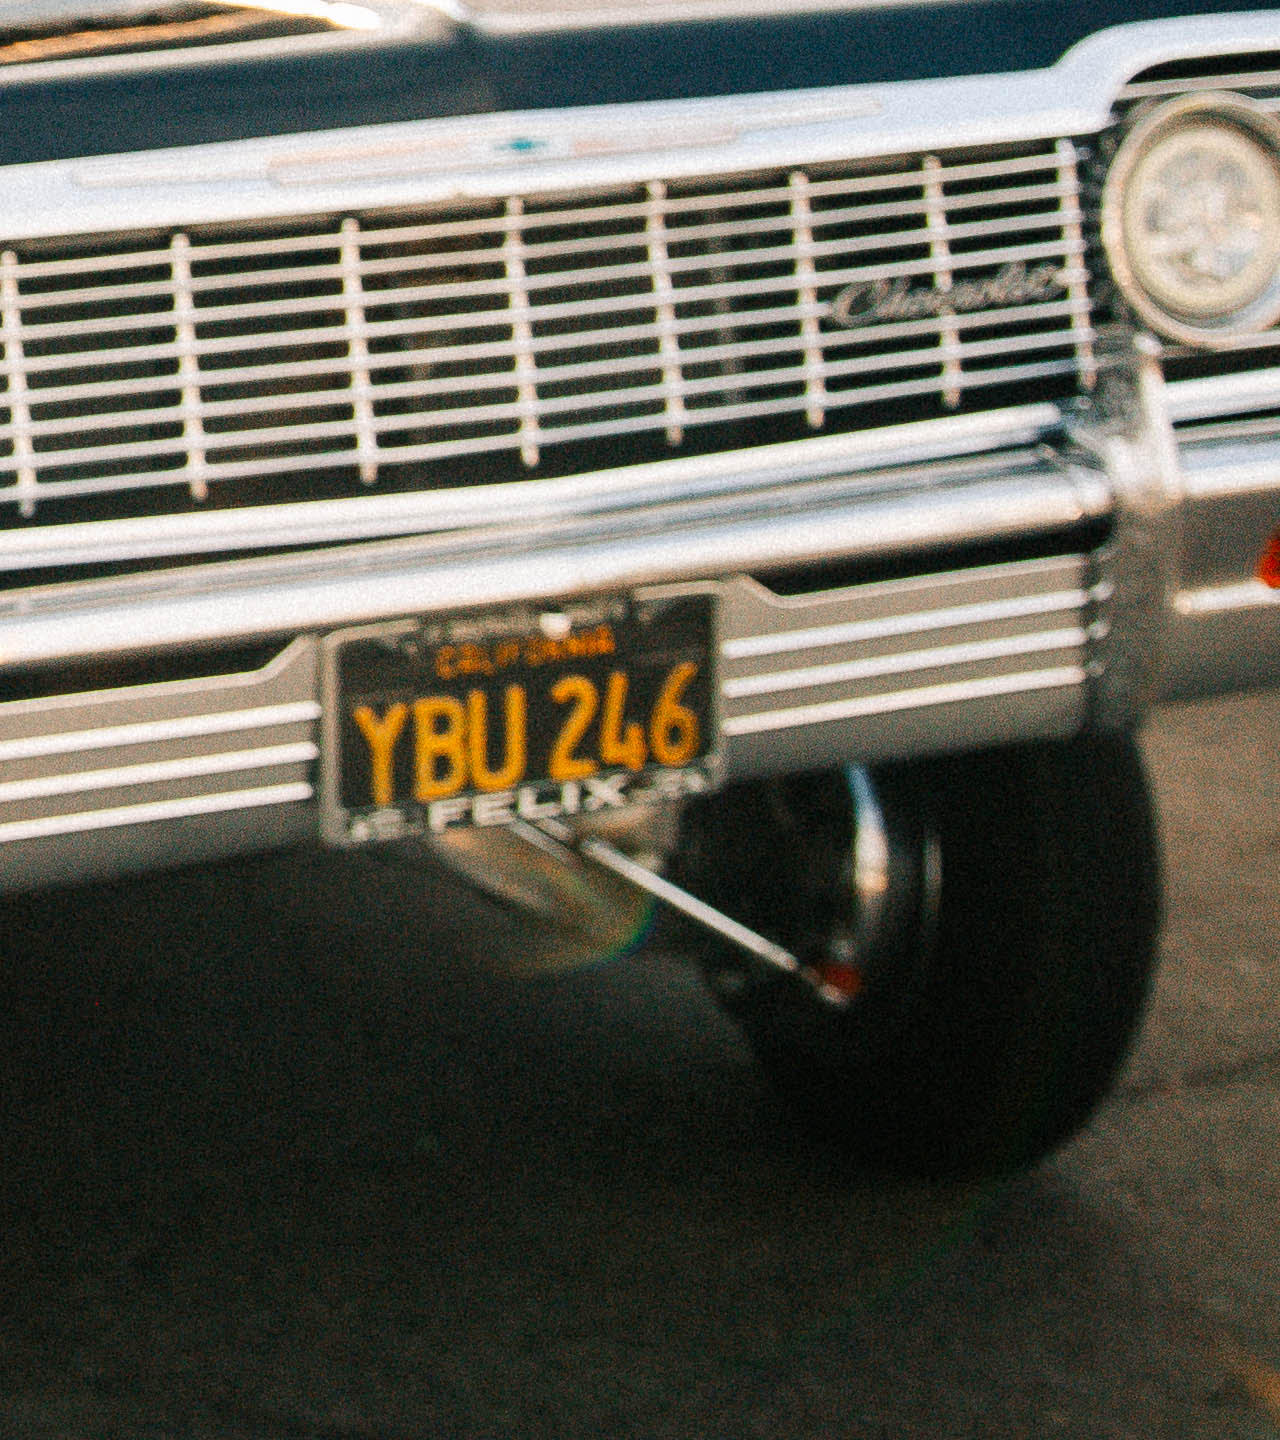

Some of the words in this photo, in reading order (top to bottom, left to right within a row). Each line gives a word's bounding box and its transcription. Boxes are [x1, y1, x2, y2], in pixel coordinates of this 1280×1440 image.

[353, 683, 528, 807] YBU
[550, 662, 700, 781] 246
[429, 776, 626, 833] FELIX
